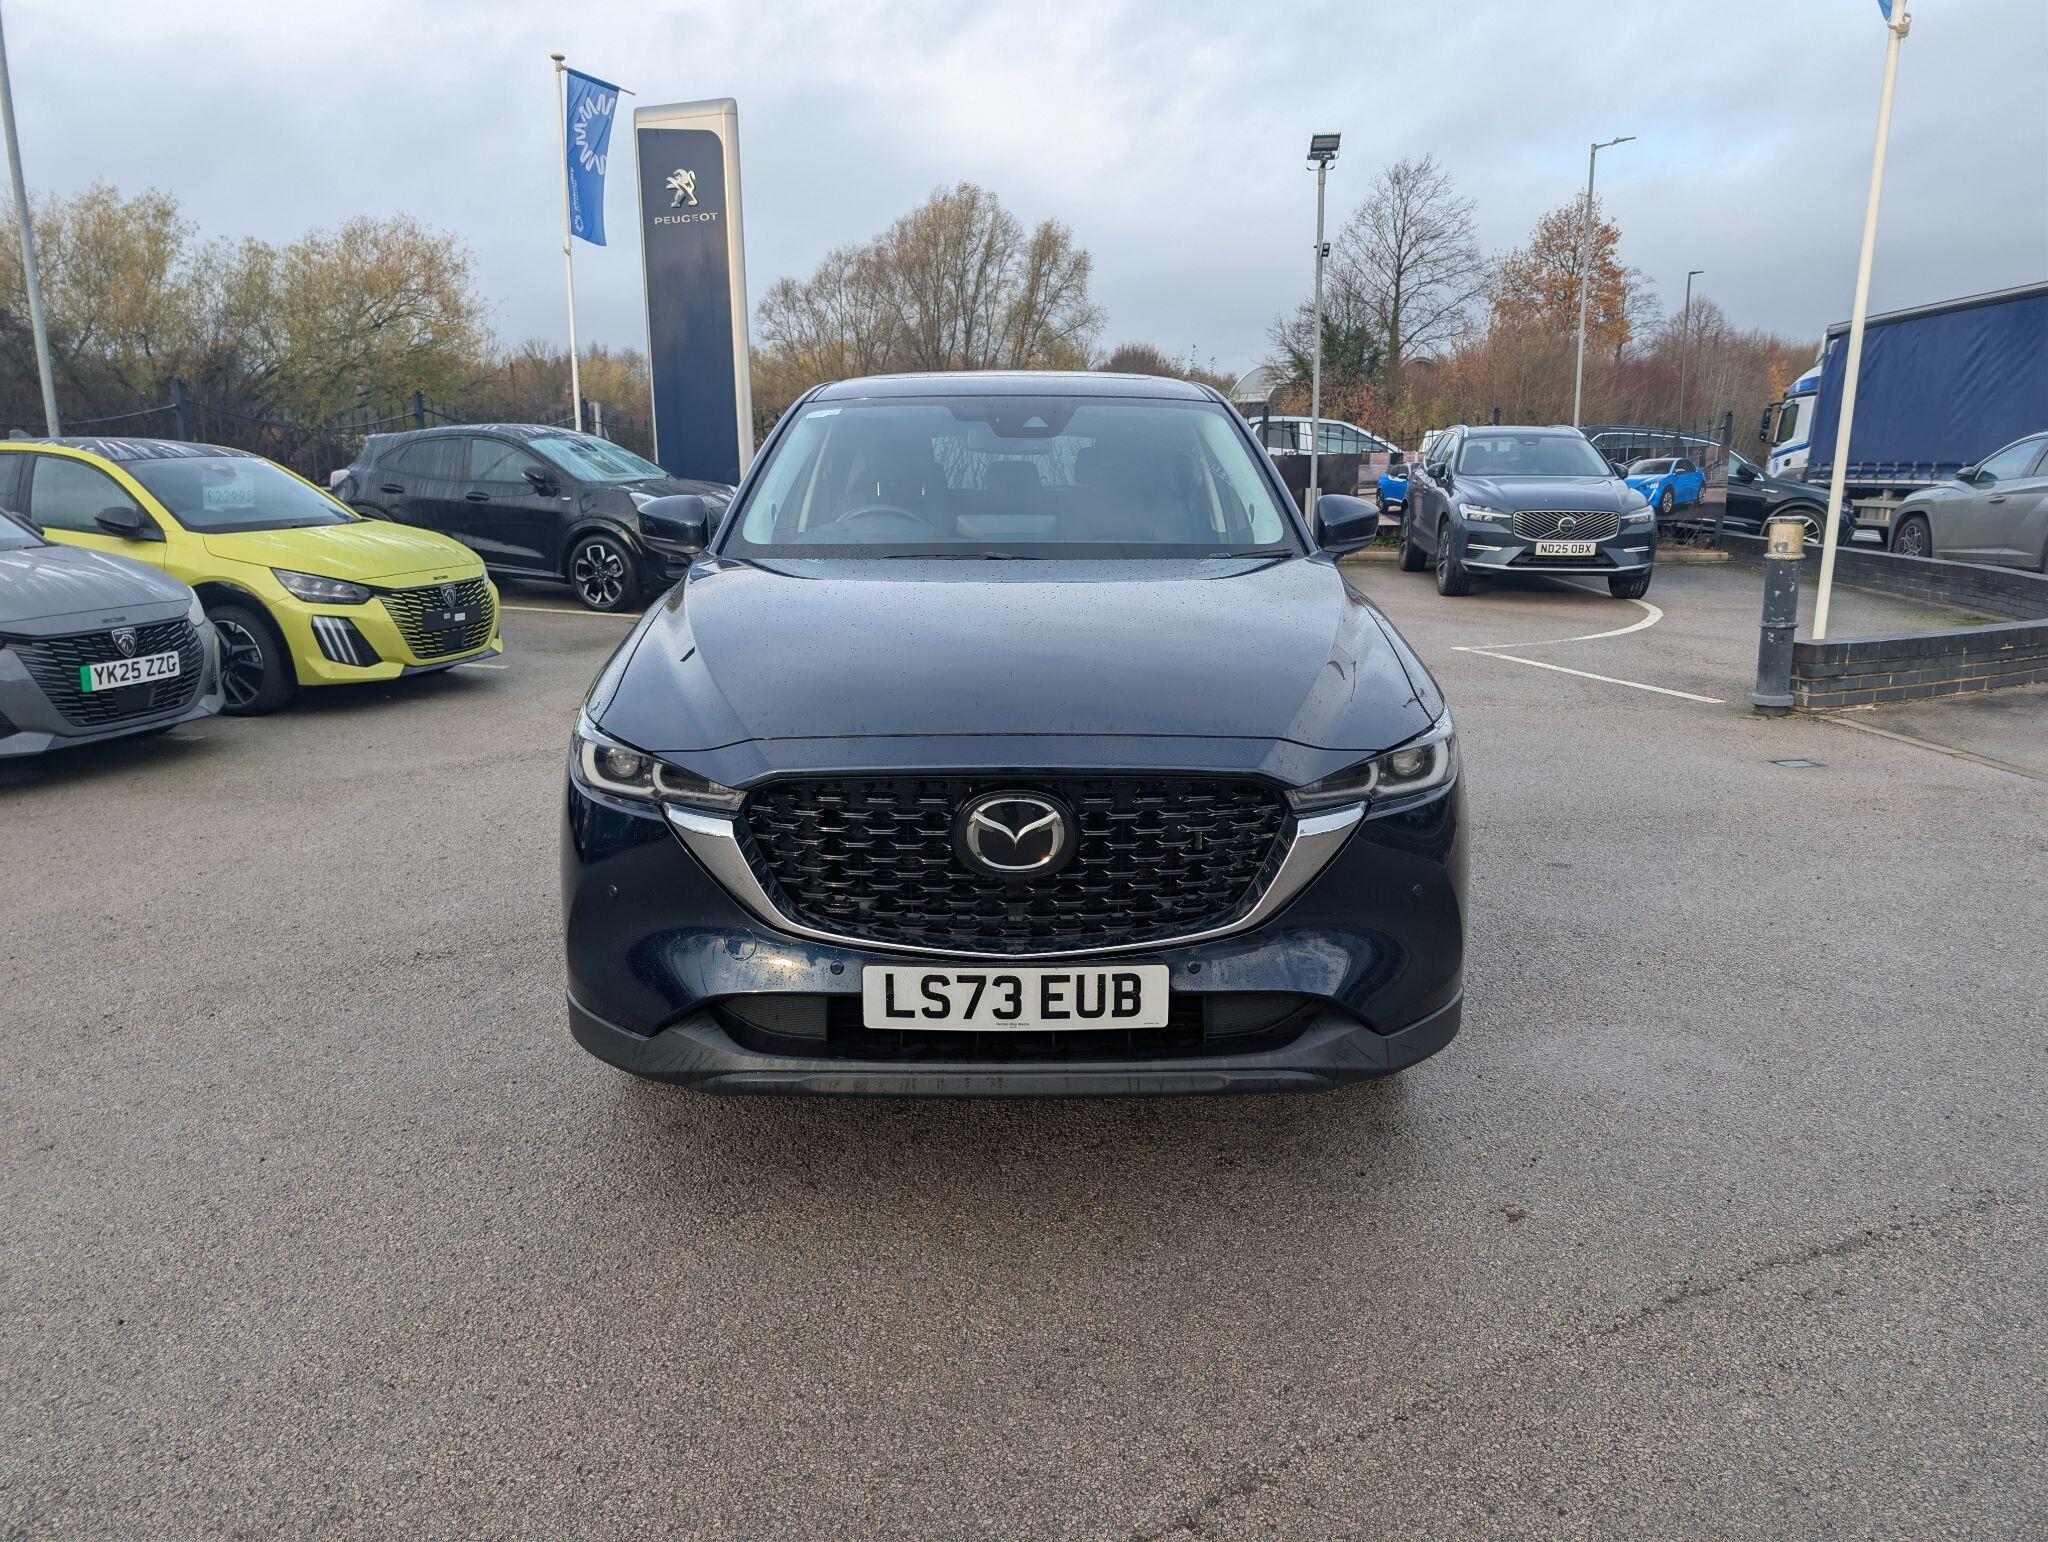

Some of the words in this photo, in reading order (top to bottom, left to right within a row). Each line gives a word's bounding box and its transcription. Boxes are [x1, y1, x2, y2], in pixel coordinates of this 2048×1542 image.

[654, 212, 718, 225] PEUGEOT
[1541, 544, 1569, 554] ND25
[1571, 544, 1592, 554] OBX
[94, 661, 142, 686] YK25
[146, 654, 177, 677] ZZG
[885, 973, 1023, 1020] LS73
[1040, 972, 1142, 1020] EUB
